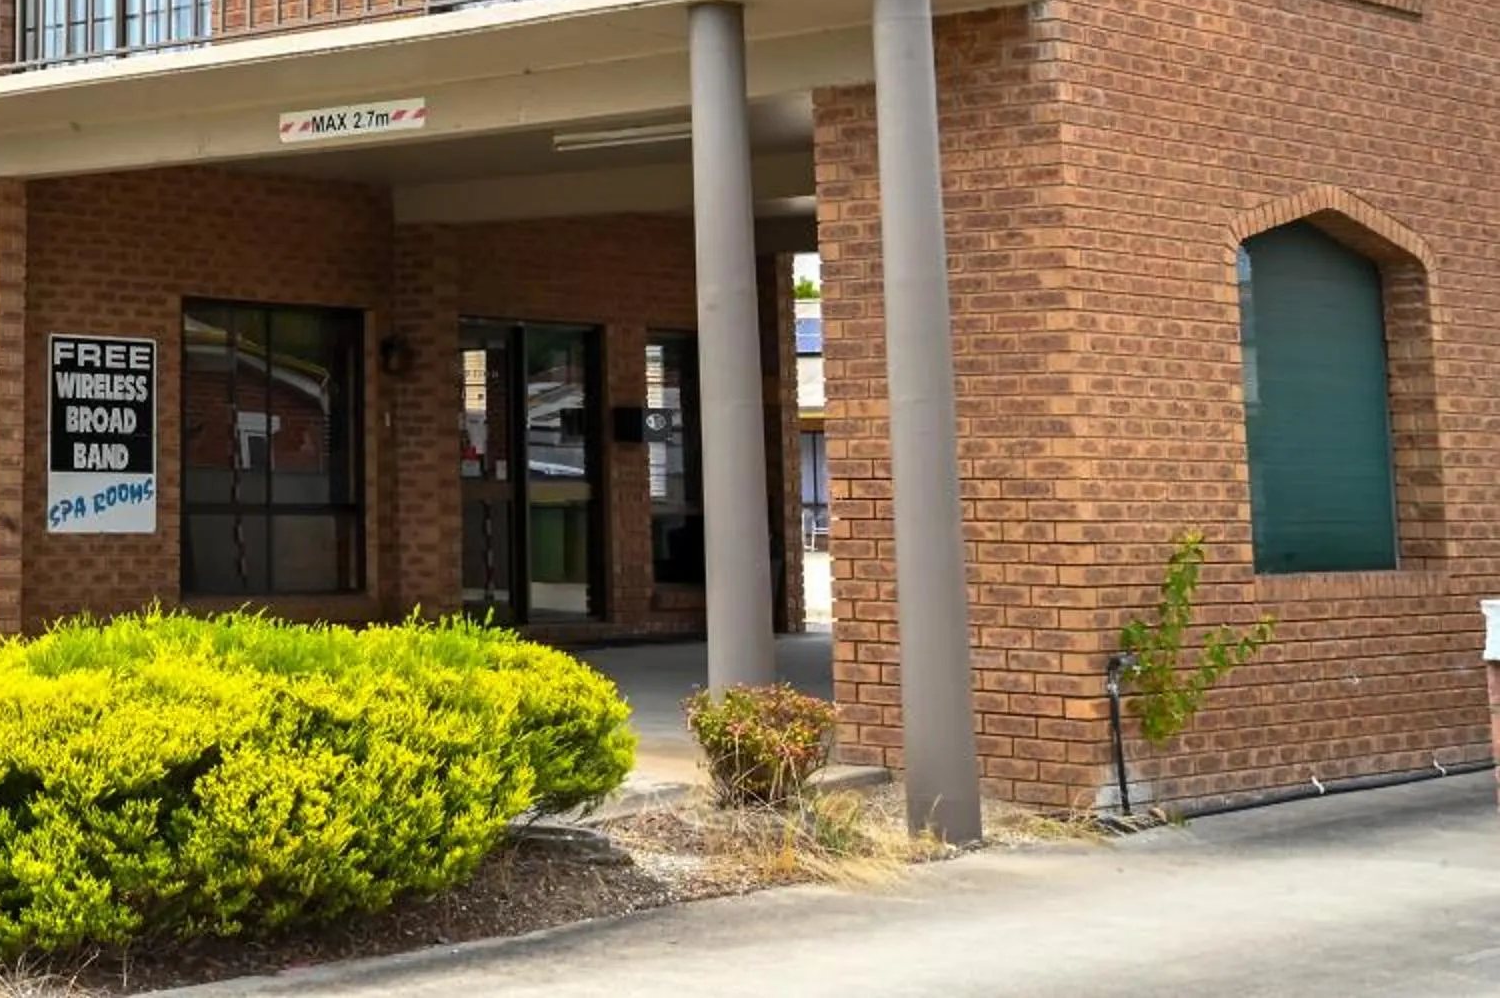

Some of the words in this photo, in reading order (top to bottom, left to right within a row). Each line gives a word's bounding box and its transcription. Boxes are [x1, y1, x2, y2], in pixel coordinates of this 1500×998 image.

[311, 113, 347, 133] MAX
[353, 111, 389, 129] 2.7m
[53, 341, 150, 369] FREE
[55, 371, 148, 402] WIRELESS
[65, 405, 136, 433] BROAD
[73, 442, 129, 470] BAND
[49, 495, 87, 528] SPA
[93, 477, 155, 516] ROOMS
